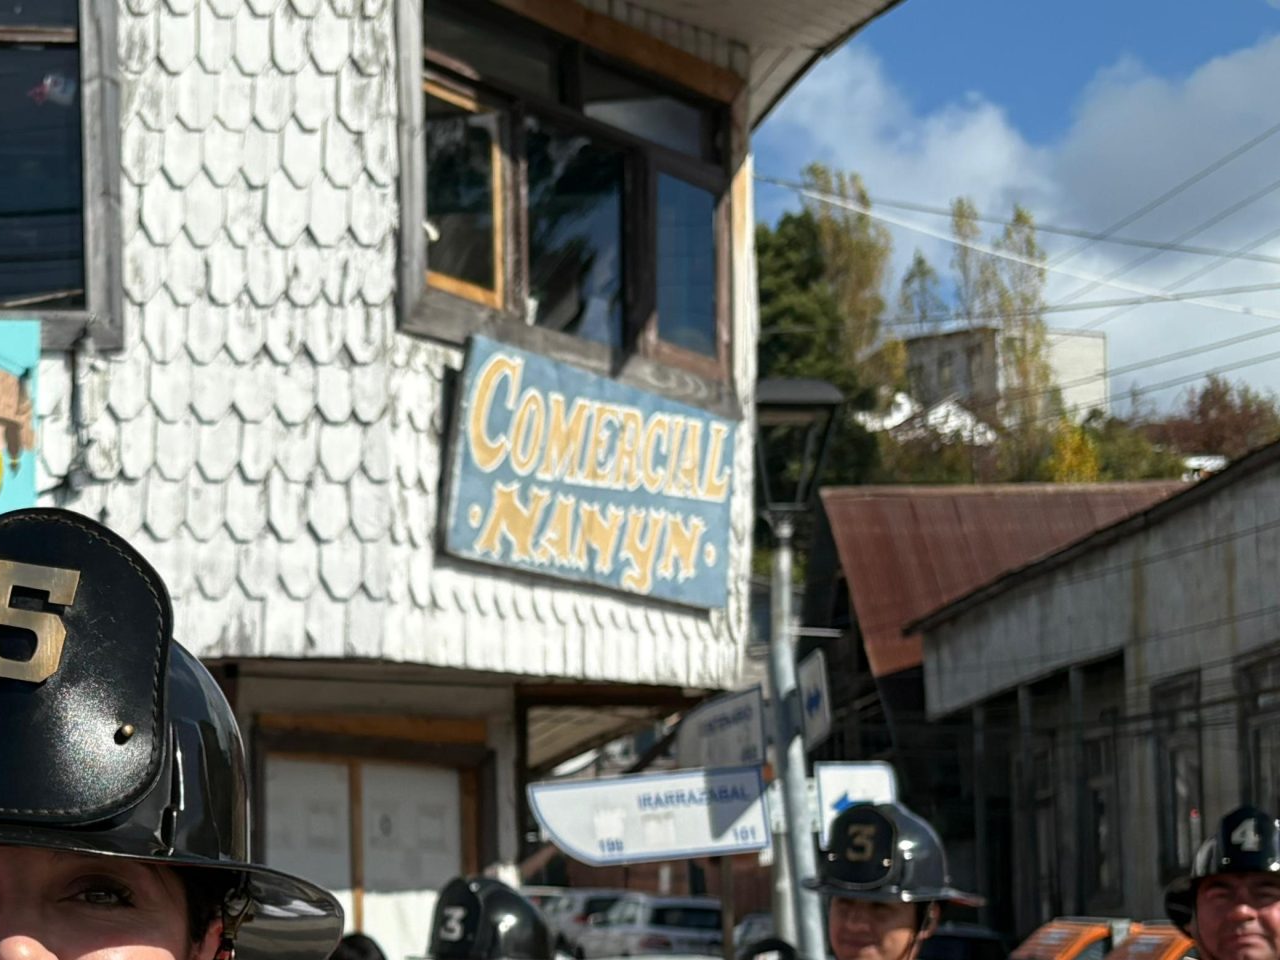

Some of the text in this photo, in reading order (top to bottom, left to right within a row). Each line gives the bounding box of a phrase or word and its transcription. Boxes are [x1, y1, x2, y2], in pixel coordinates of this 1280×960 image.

[468, 352, 731, 503] COMERCIAL
[845, 823, 876, 862] 3
[1231, 818, 1261, 852] 4
[439, 906, 467, 942] 3
